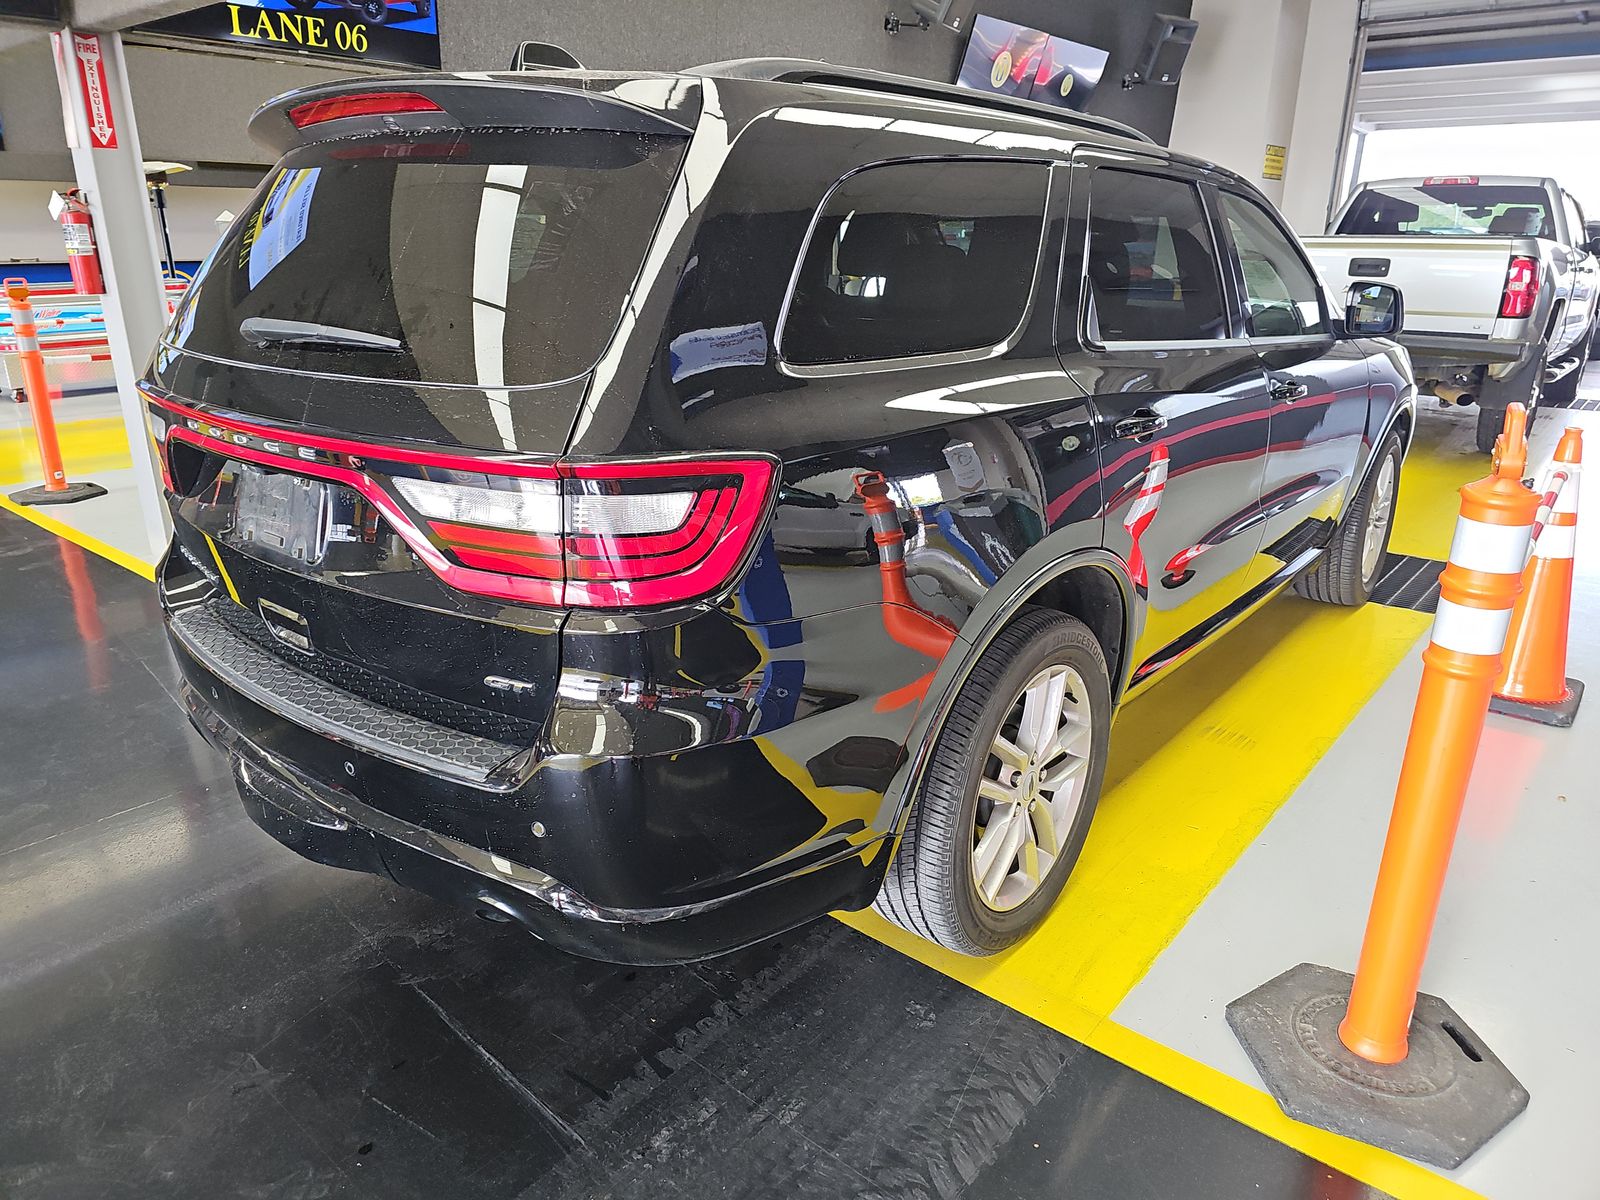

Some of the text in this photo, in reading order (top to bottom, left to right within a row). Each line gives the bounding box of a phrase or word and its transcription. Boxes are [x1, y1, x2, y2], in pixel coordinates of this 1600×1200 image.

[77, 42, 98, 54] FIRE
[227, 4, 369, 53] LANE 06
[86, 58, 108, 139] EXTINGUISHER
[186, 418, 317, 460] DODGE
[483, 674, 536, 694] GT
